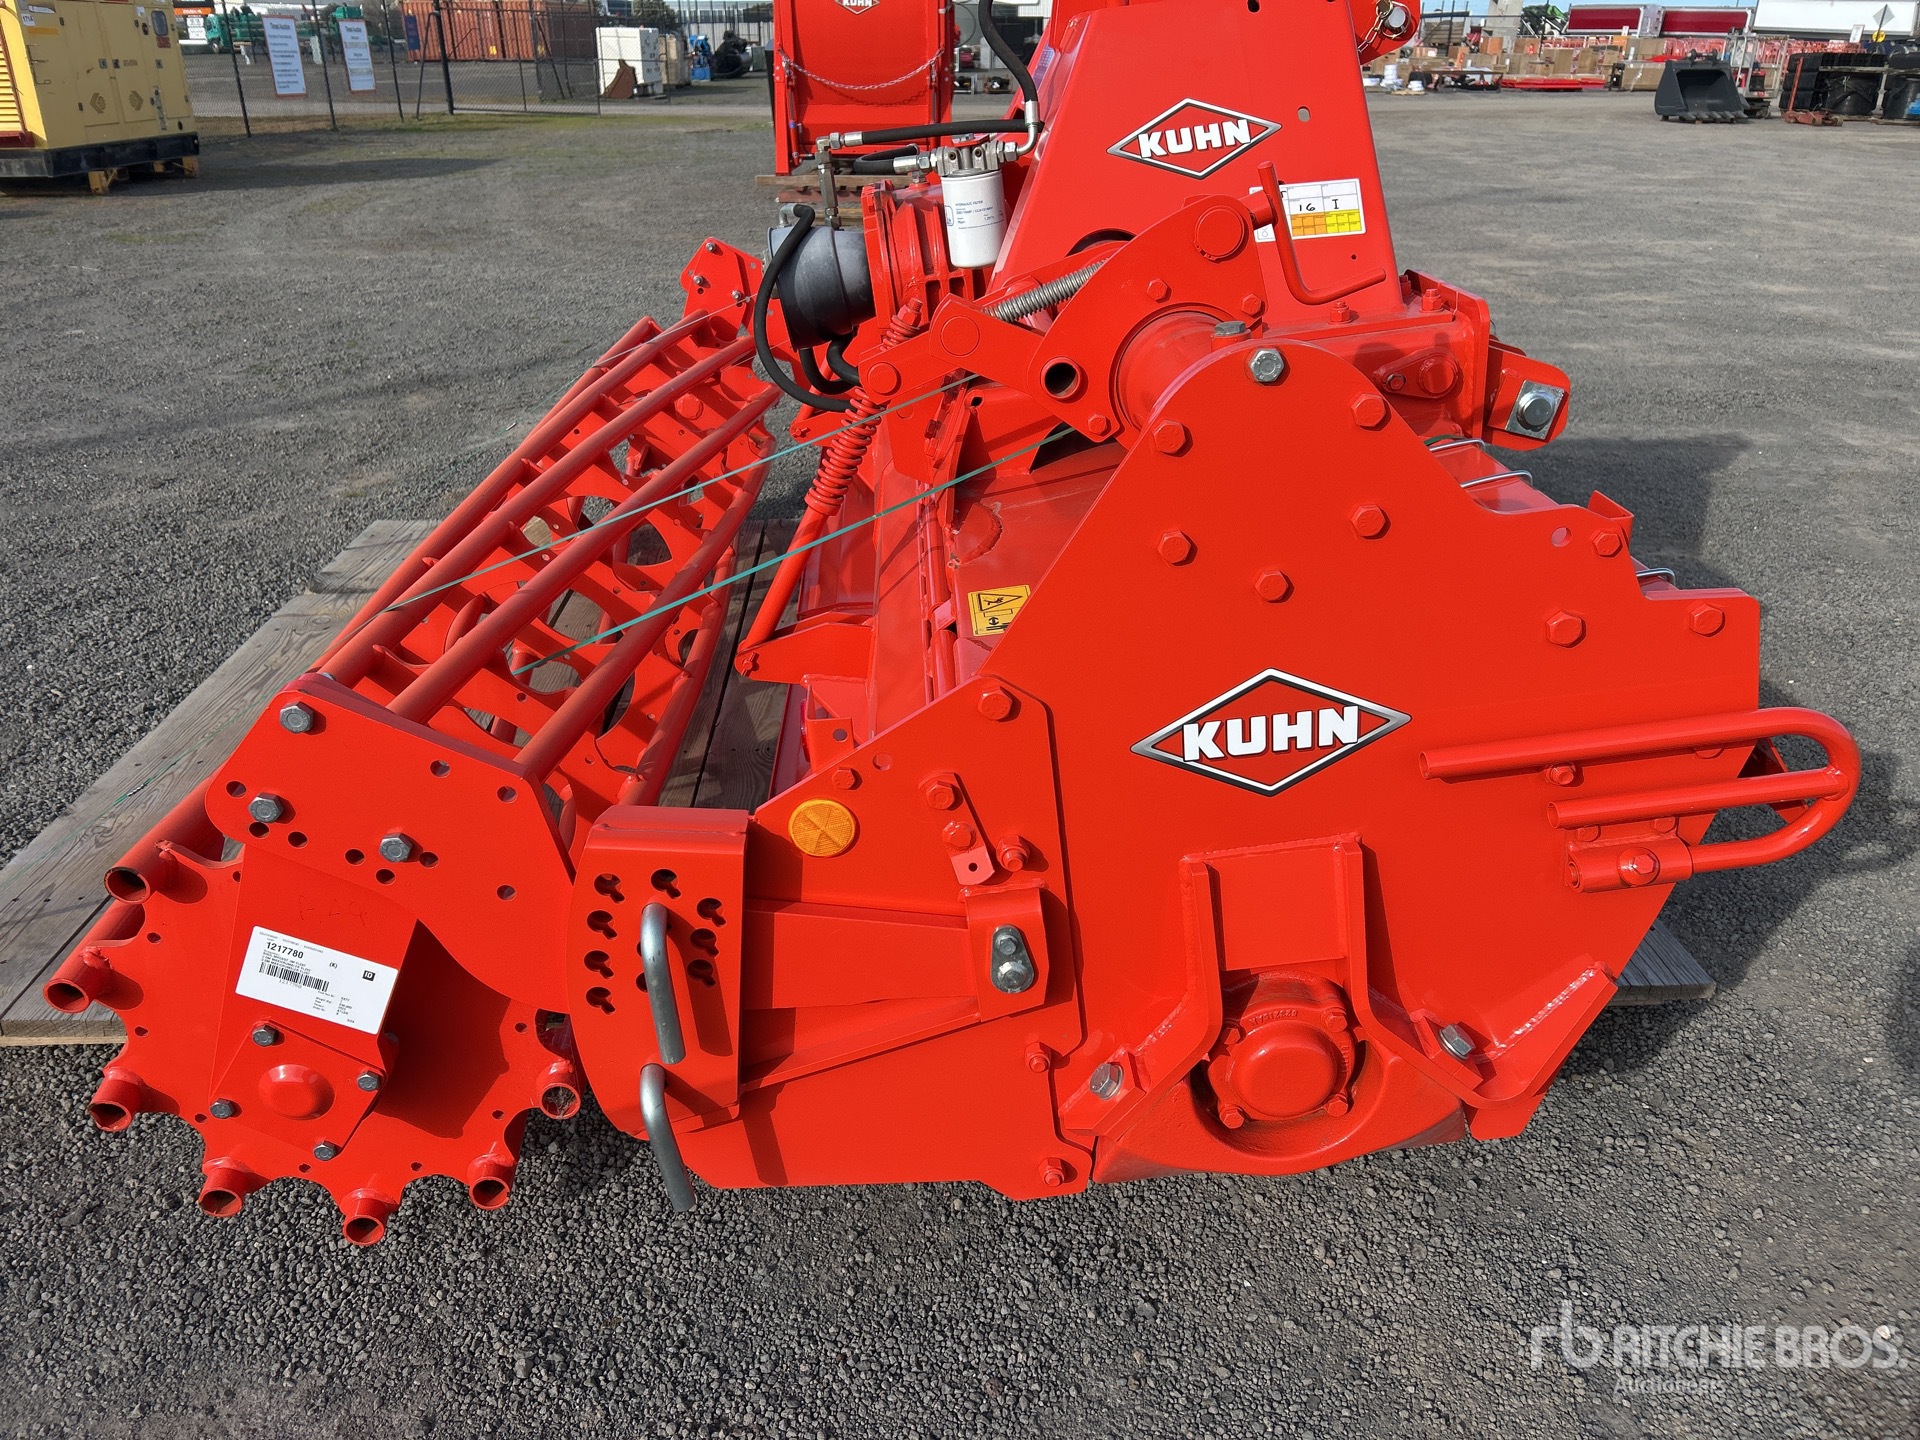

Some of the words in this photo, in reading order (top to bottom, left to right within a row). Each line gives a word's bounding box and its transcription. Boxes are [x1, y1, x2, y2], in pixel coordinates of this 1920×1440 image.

[1137, 119, 1251, 158] KUHN
[1331, 199, 1339, 209] I
[1183, 706, 1359, 762] KUHN
[266, 941, 304, 958] 1217780
